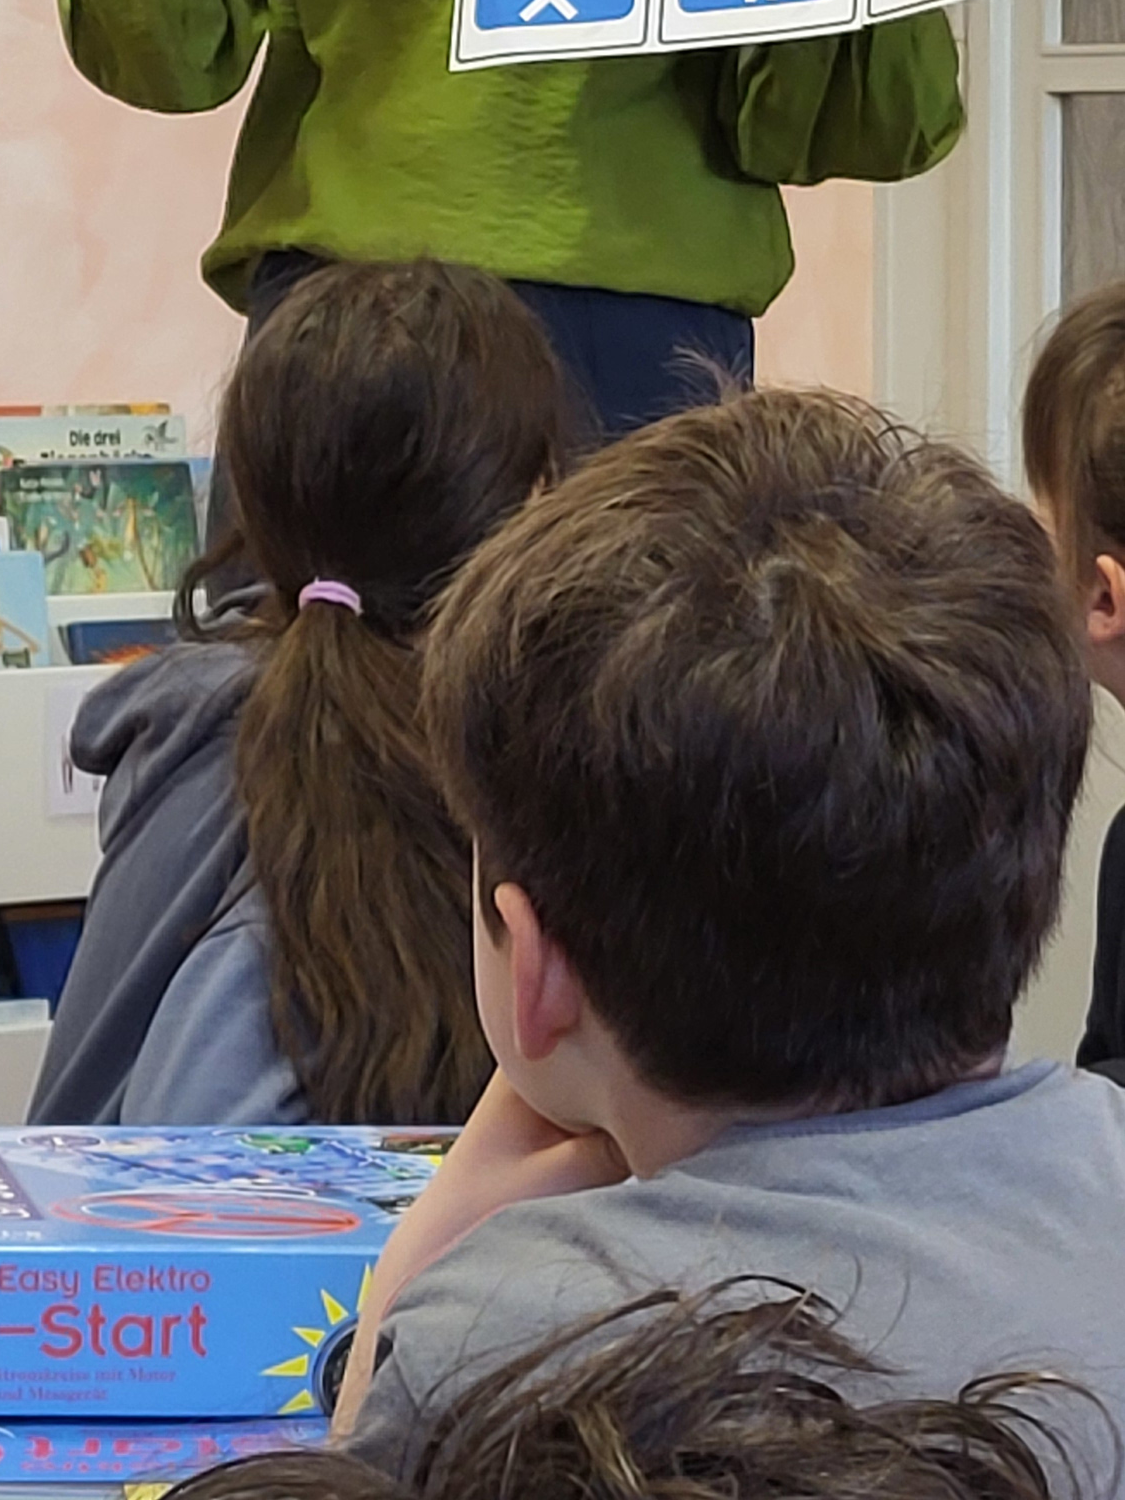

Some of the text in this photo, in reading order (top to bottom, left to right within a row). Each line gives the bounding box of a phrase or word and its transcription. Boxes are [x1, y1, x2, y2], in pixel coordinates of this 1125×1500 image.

[70, 429, 121, 446] Die drei
[93, 1265, 211, 1292] Elektro
[95, 1368, 122, 1382] mit
